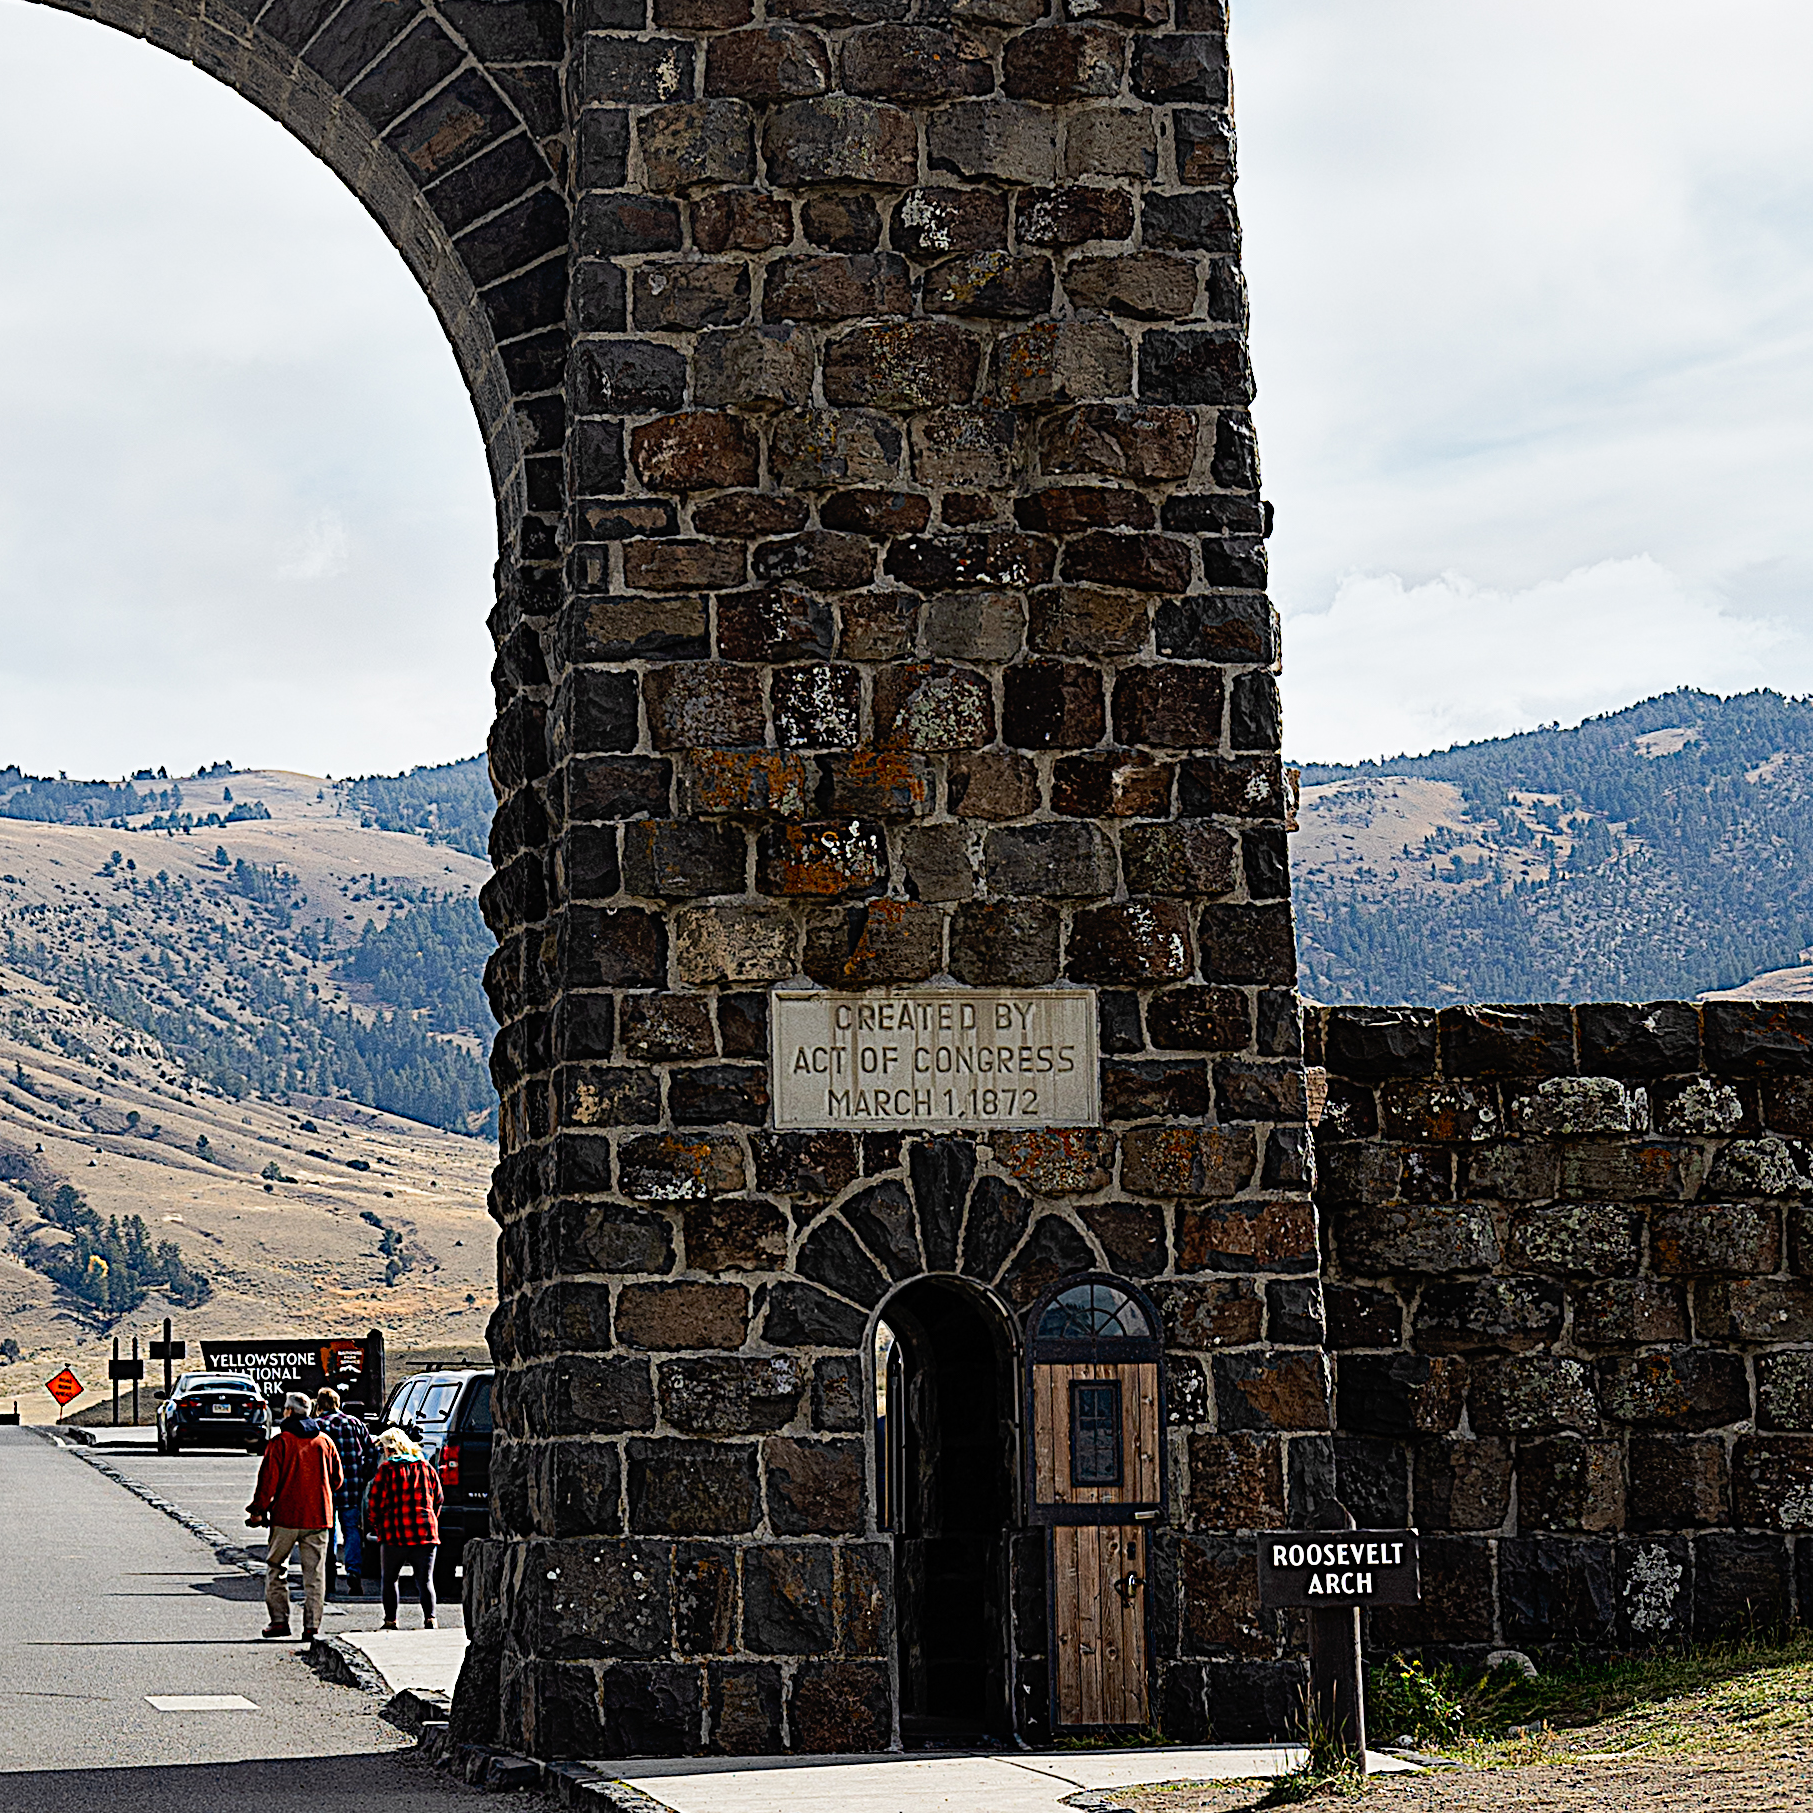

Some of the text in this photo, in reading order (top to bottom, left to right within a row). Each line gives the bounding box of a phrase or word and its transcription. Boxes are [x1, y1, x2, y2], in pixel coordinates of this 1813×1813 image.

[835, 1001, 1034, 1031] CREATED BY
[793, 1044, 1076, 1074] ACT OF CONGRESS
[827, 1088, 932, 1117] MARCH
[209, 1351, 317, 1368] YELLOWSTONE
[1272, 1542, 1404, 1567] ROOSEVELT
[1307, 1572, 1373, 1595] ARCH
